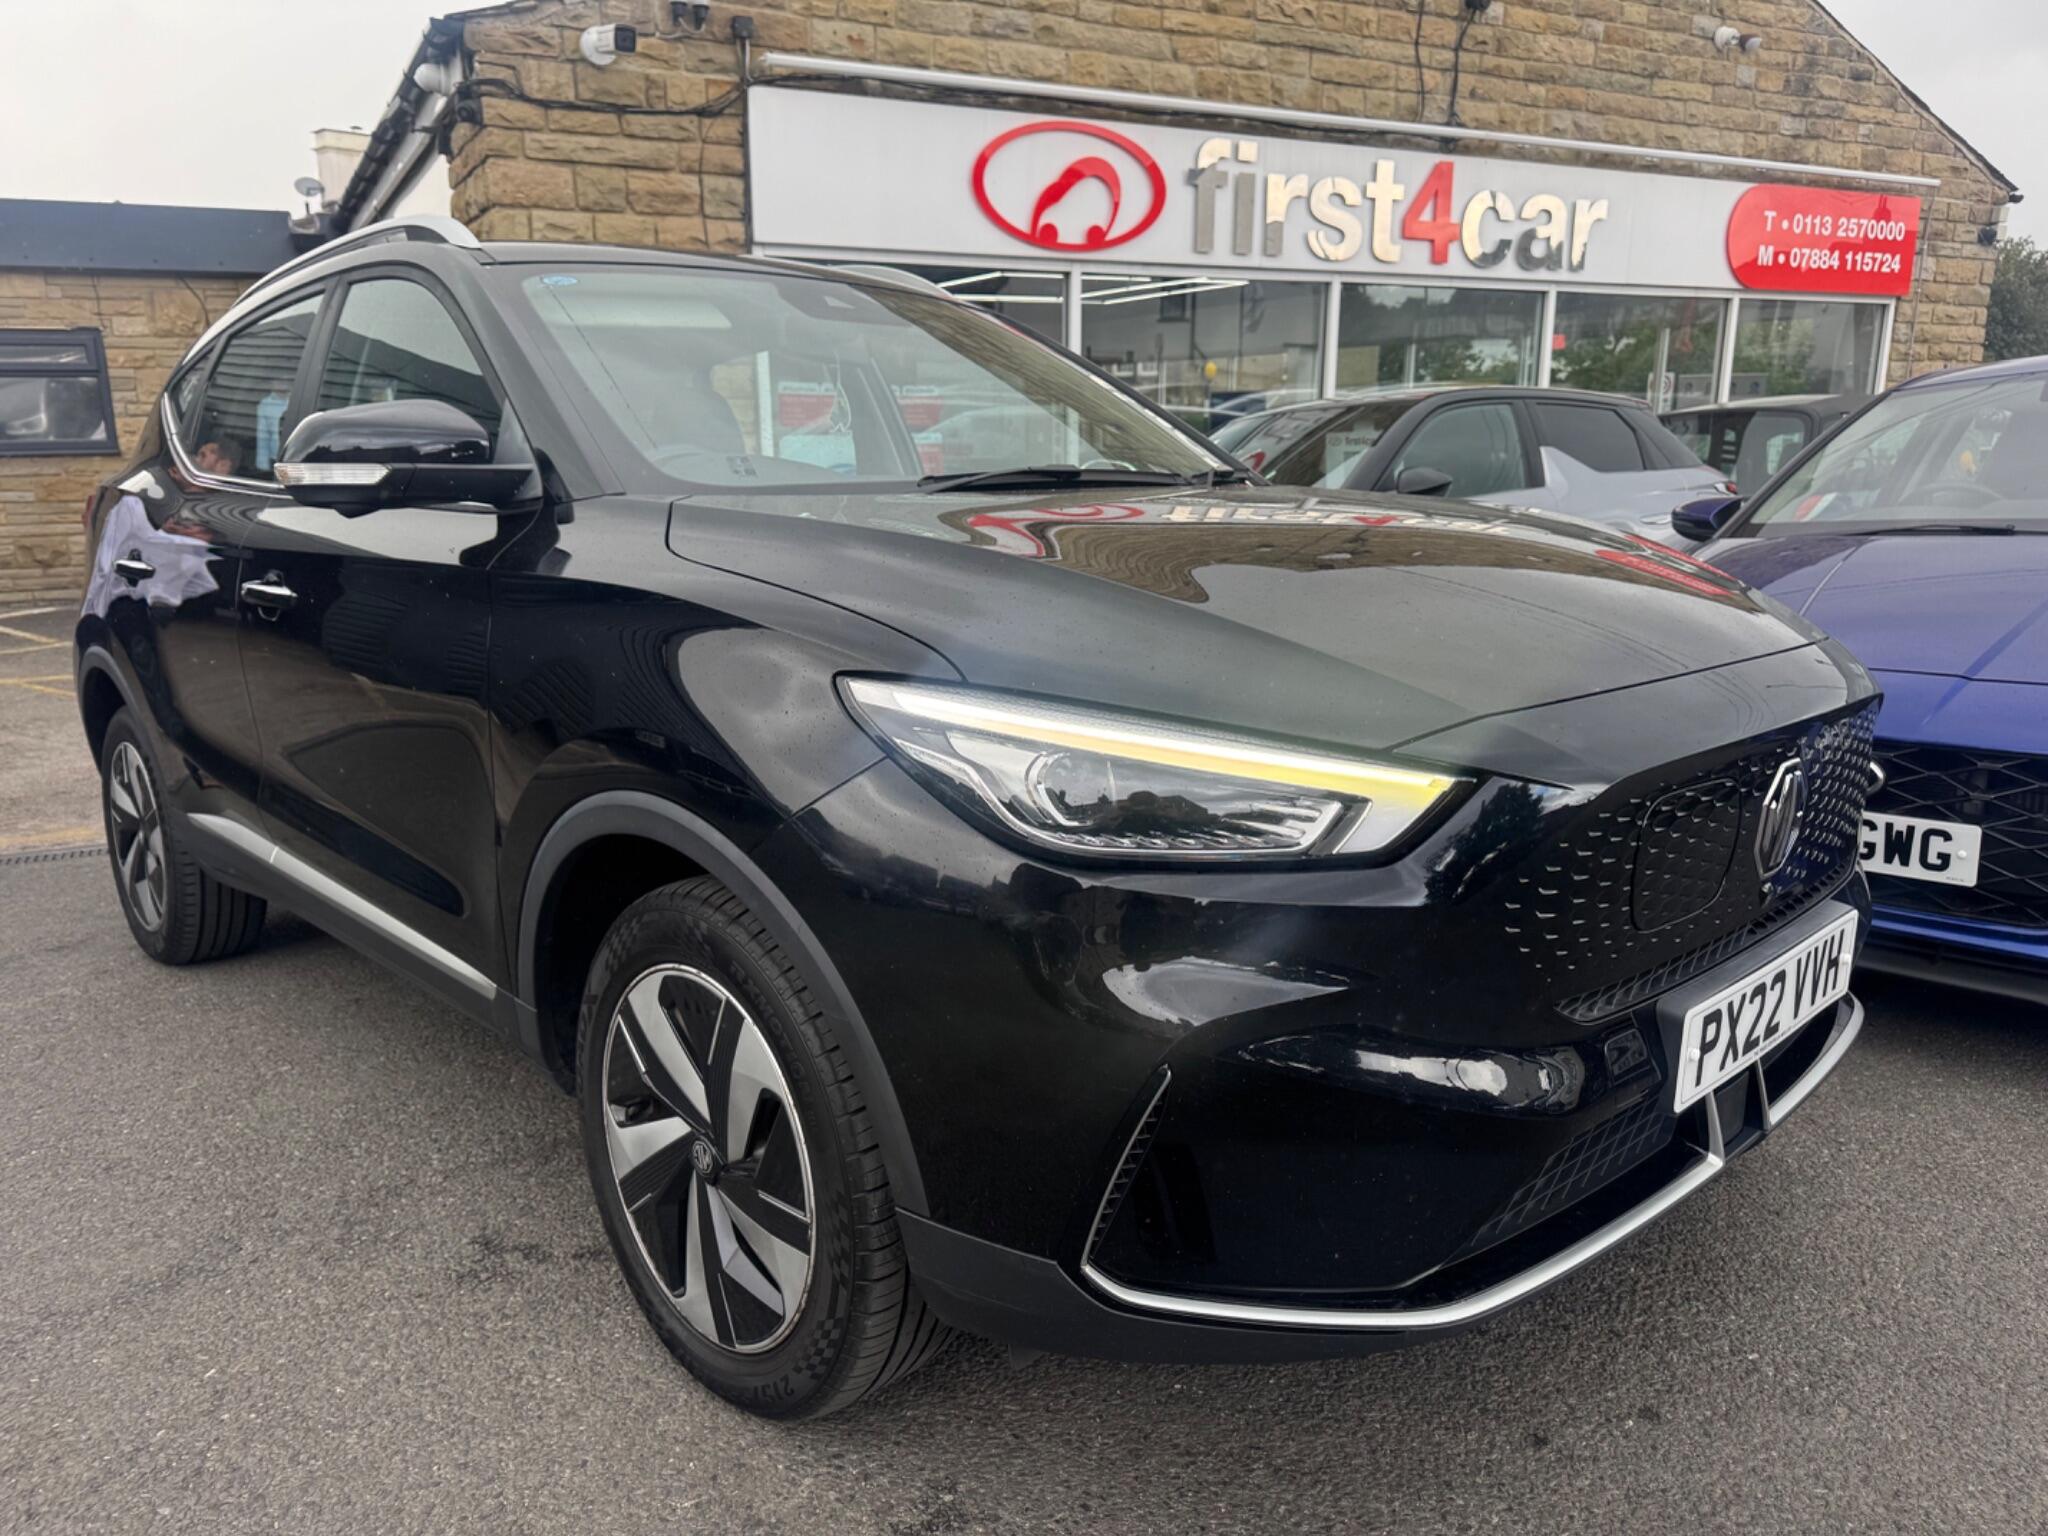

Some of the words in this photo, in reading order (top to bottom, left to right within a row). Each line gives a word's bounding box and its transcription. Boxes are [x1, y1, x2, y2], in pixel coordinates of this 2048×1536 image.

[1186, 137, 1609, 273] first4car
[1763, 210, 1777, 232] T
[1792, 213, 1832, 236] 0113
[1836, 216, 1906, 242] 2570000
[1757, 244, 1774, 267] M
[1789, 247, 1840, 270] 07884
[1845, 251, 1901, 273] 115724
[1694, 968, 1787, 1089] PX22
[1793, 928, 1846, 1020] VVH
